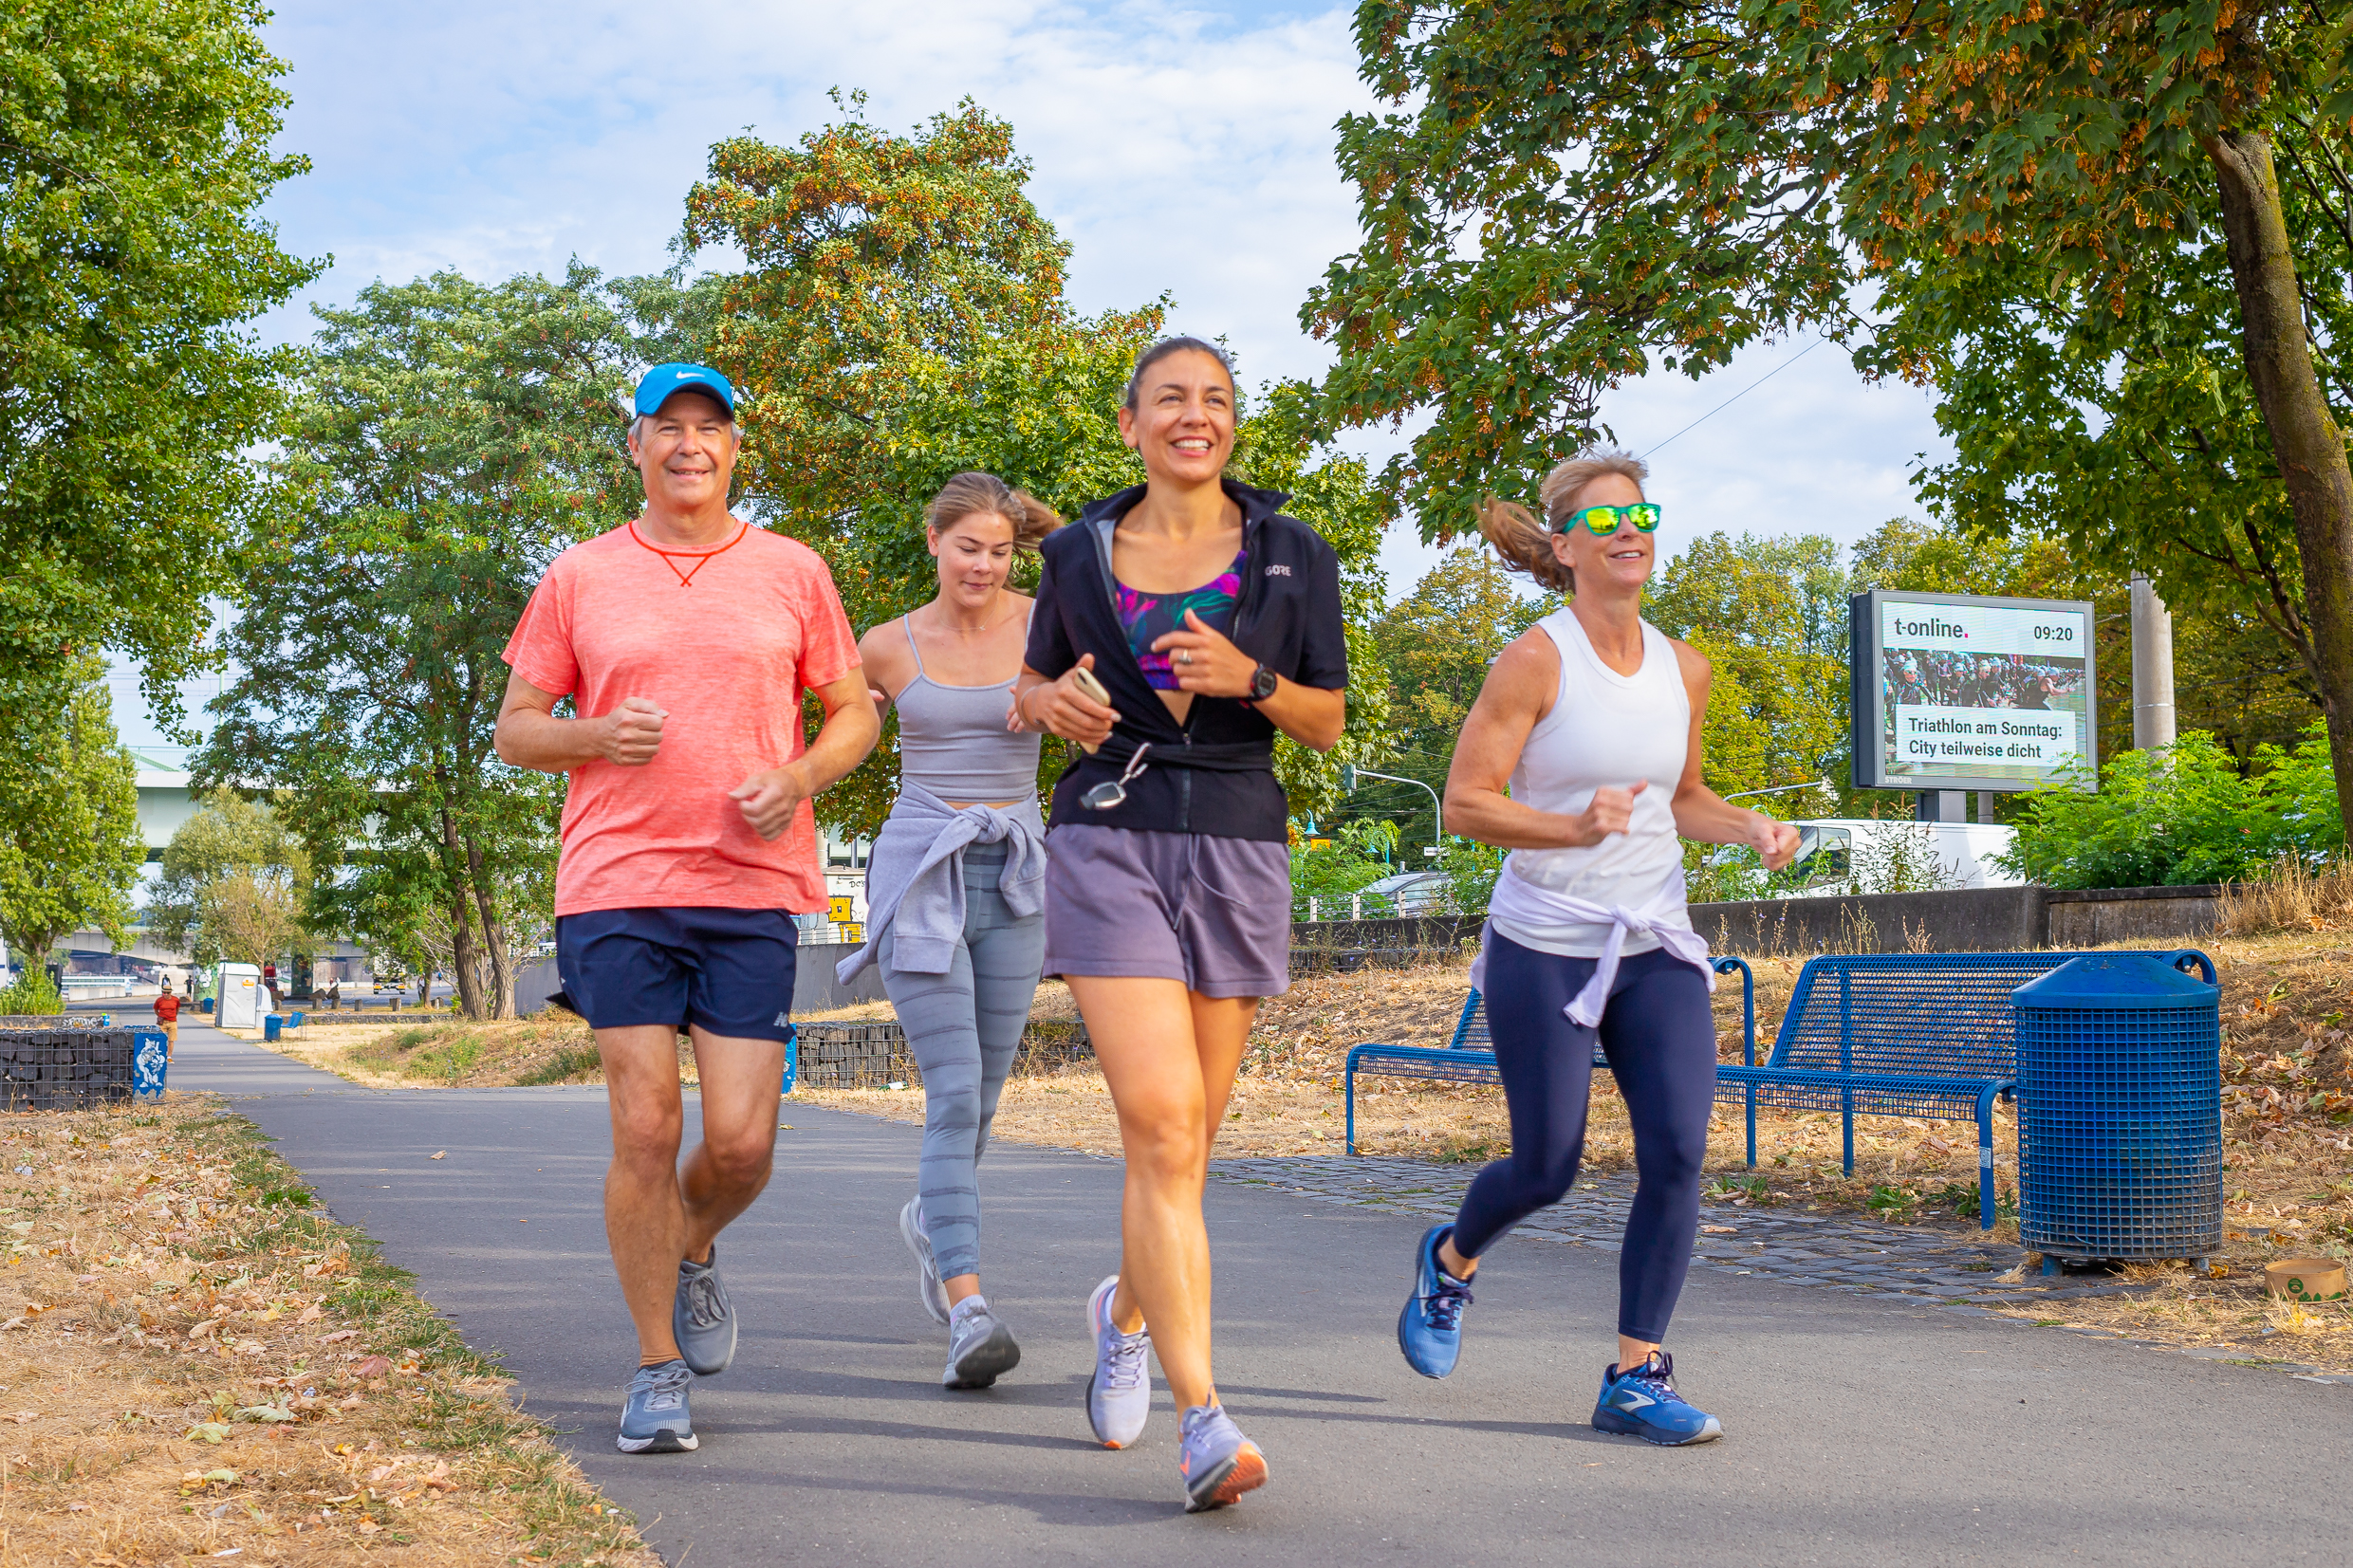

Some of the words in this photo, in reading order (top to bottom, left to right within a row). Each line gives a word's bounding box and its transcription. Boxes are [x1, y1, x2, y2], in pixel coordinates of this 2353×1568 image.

[1265, 564, 1291, 577] GORE
[1895, 618, 1969, 638] t-online.
[2033, 626, 2073, 641] 09:20
[1908, 717, 1972, 733] Triathlon
[1975, 722, 1997, 734] am
[2001, 721, 2063, 740] Sonntag:
[1908, 740, 1936, 757] City
[1940, 741, 2003, 756] teilweise
[2007, 744, 2042, 758] dicht
[1884, 775, 1913, 784] STRÖER
